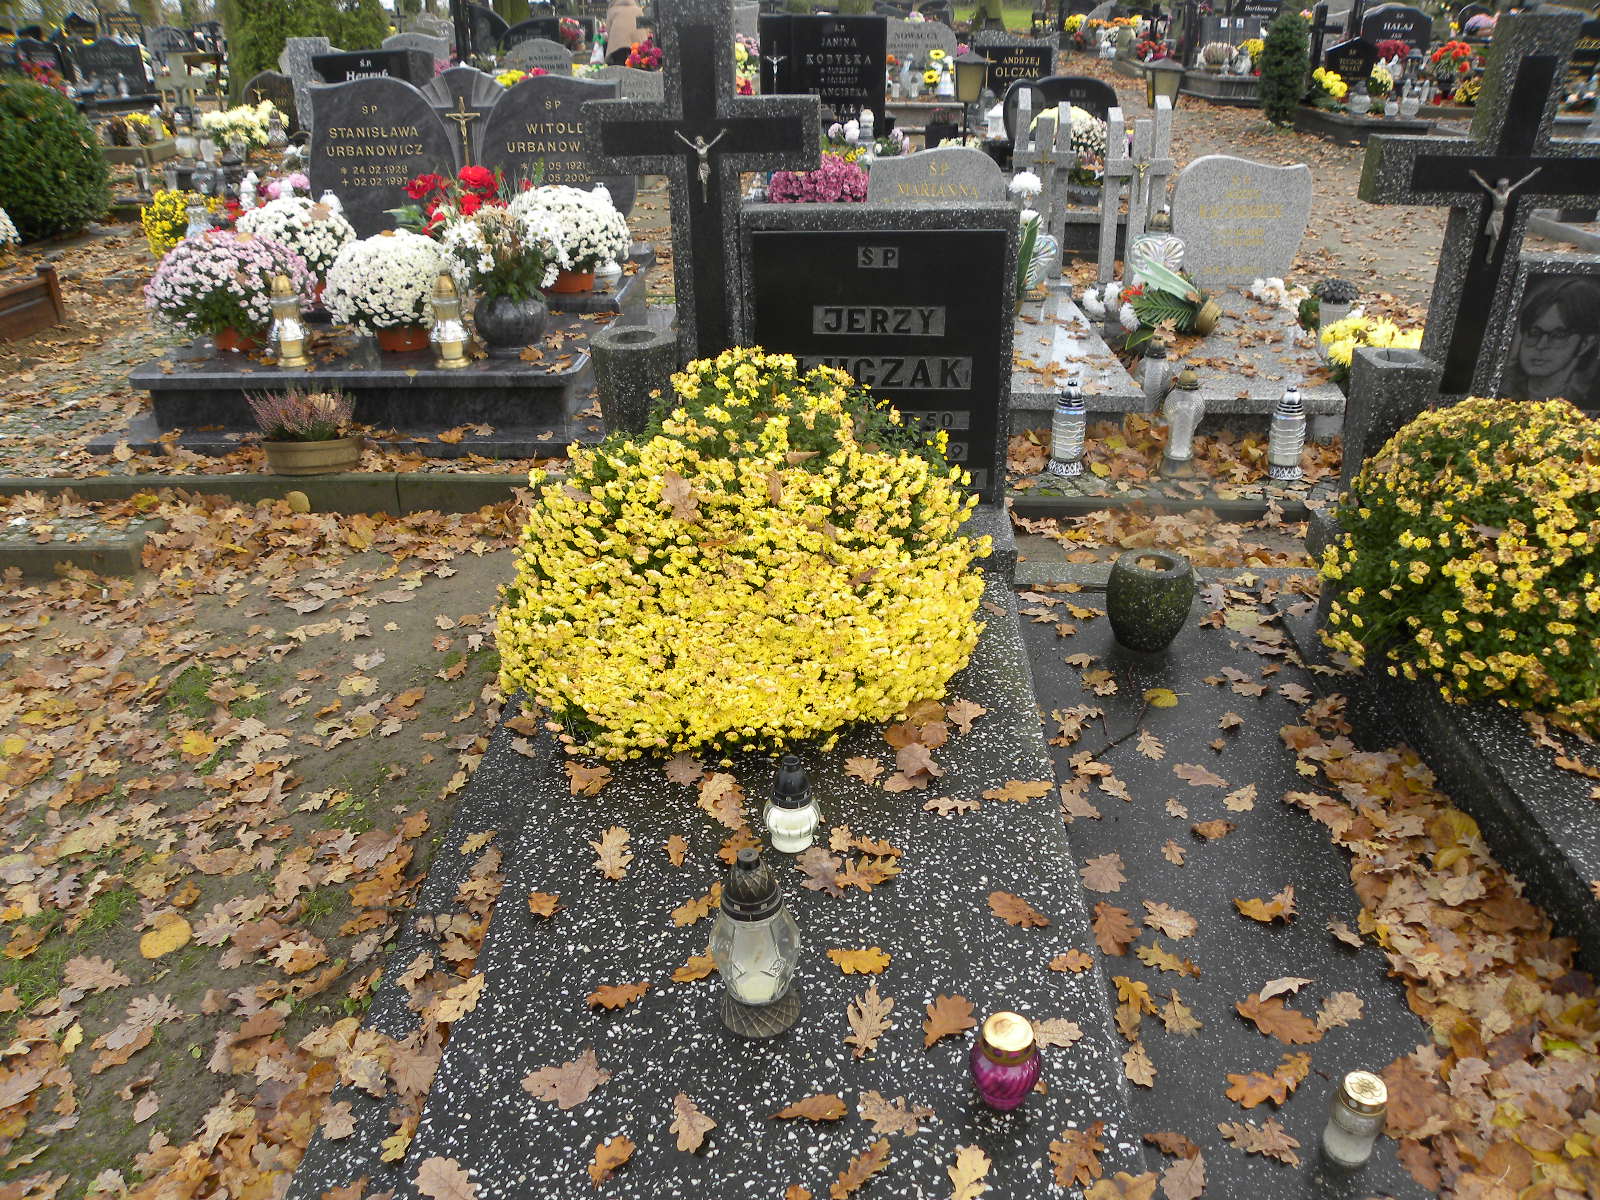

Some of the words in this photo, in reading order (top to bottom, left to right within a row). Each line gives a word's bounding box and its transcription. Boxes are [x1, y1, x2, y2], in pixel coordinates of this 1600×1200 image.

[1003, 57, 1041, 66] ANDRZEJ
[995, 66, 1040, 78] OLCZAK
[326, 143, 424, 157] URBANOWICZ
[506, 140, 585, 153] URBANOW
[824, 306, 936, 334] JERZY
